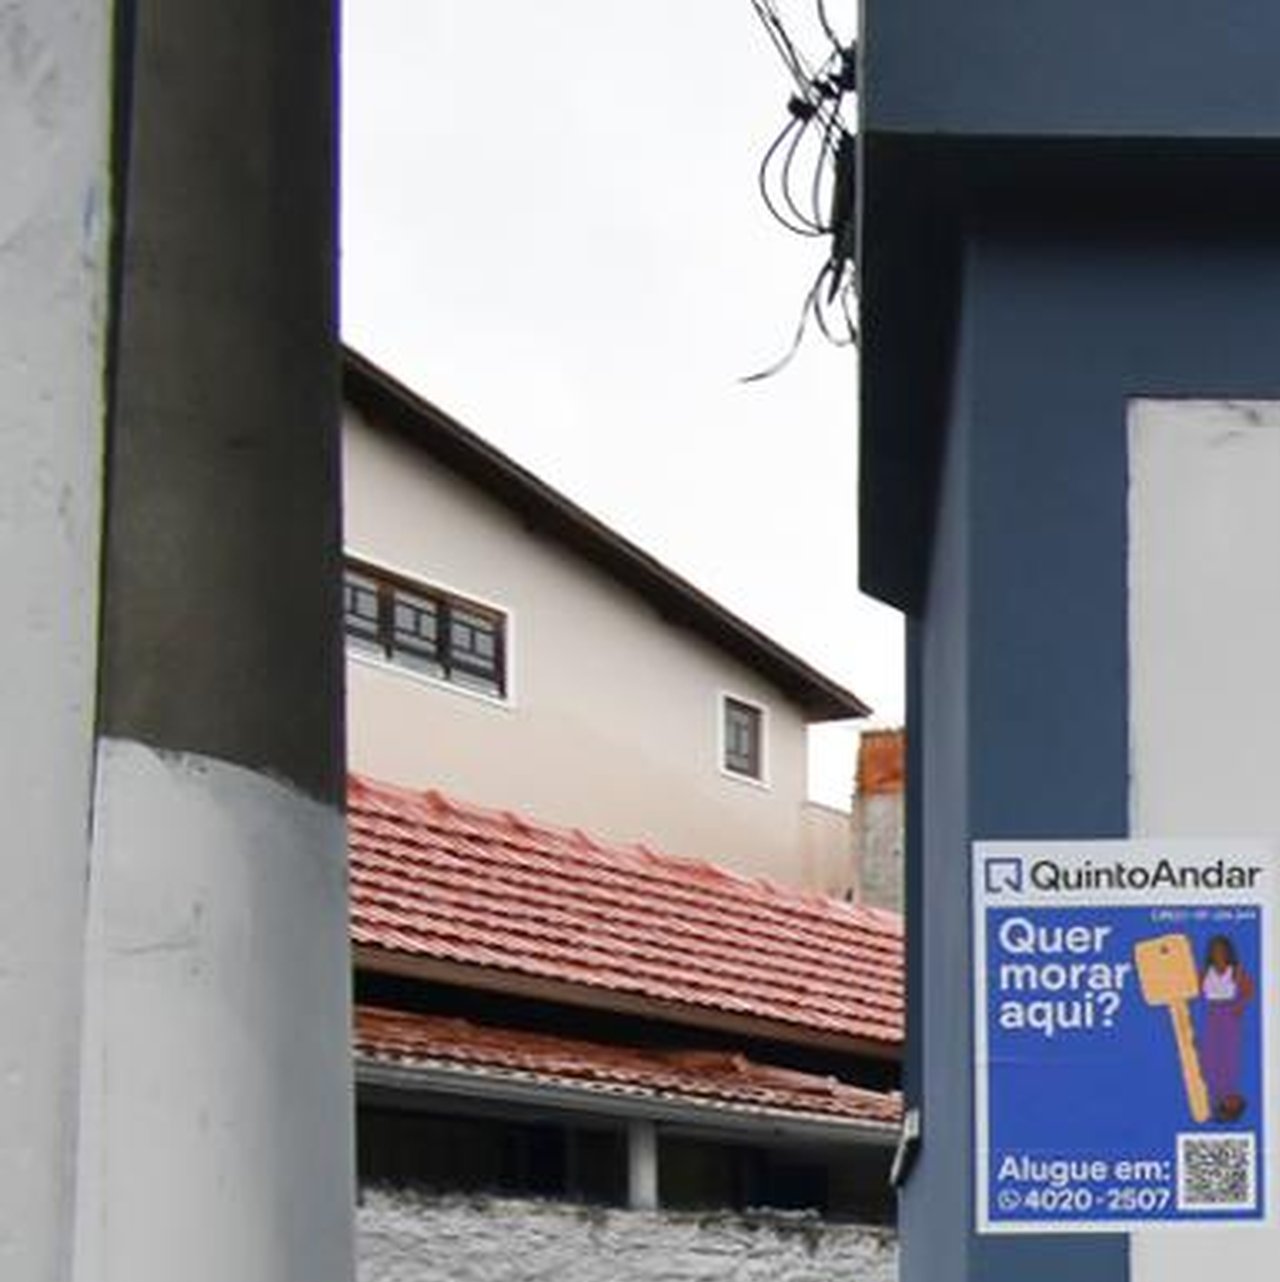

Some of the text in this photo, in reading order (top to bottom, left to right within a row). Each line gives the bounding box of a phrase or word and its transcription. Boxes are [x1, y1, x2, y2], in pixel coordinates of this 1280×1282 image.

[1030, 859, 1262, 891] QuintoAndar
[998, 918, 1111, 953] Quer
[998, 960, 1133, 989] morar
[999, 992, 1119, 1036] aqui?
[998, 1155, 1171, 1188] Alugue em:
